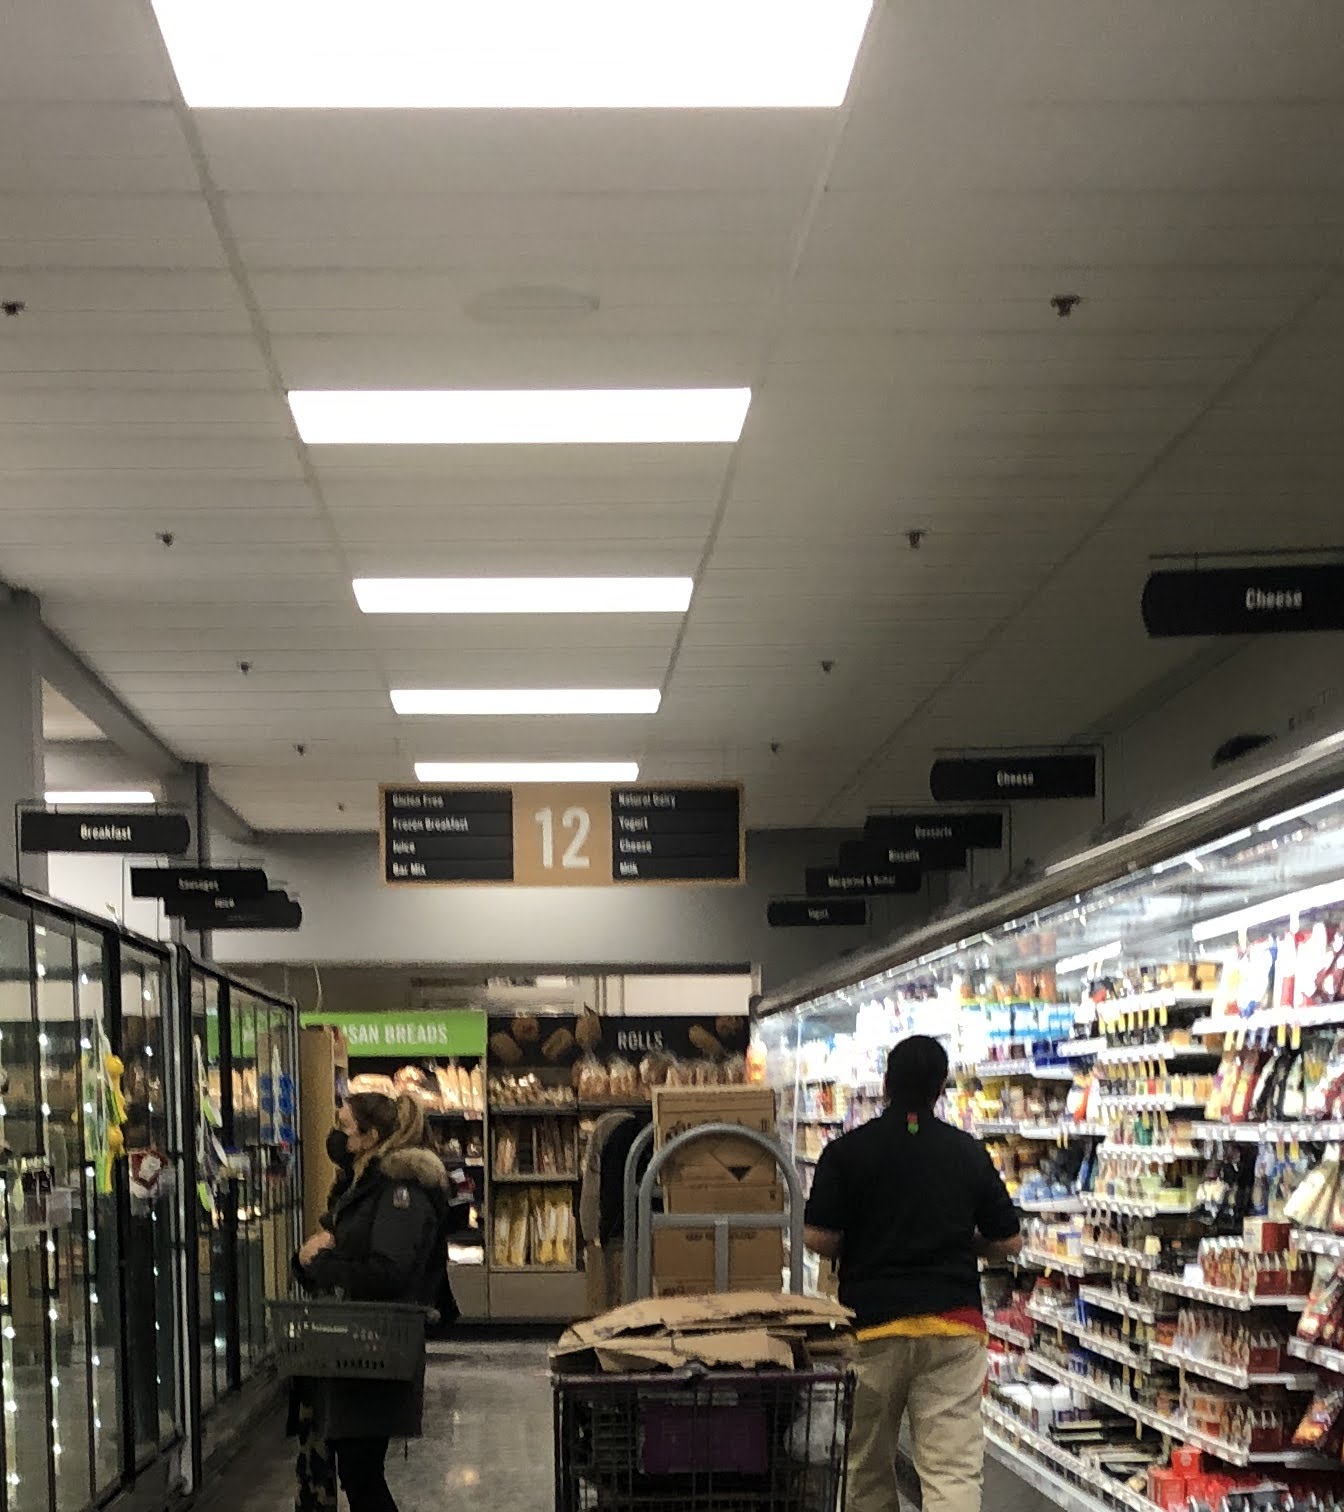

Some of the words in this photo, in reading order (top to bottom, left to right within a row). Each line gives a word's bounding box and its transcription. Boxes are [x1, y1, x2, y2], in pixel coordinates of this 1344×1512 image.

[1245, 586, 1304, 610] Cheese
[535, 806, 592, 870] 12
[384, 1023, 449, 1045] BREADS
[617, 1029, 664, 1052] ROLLS
